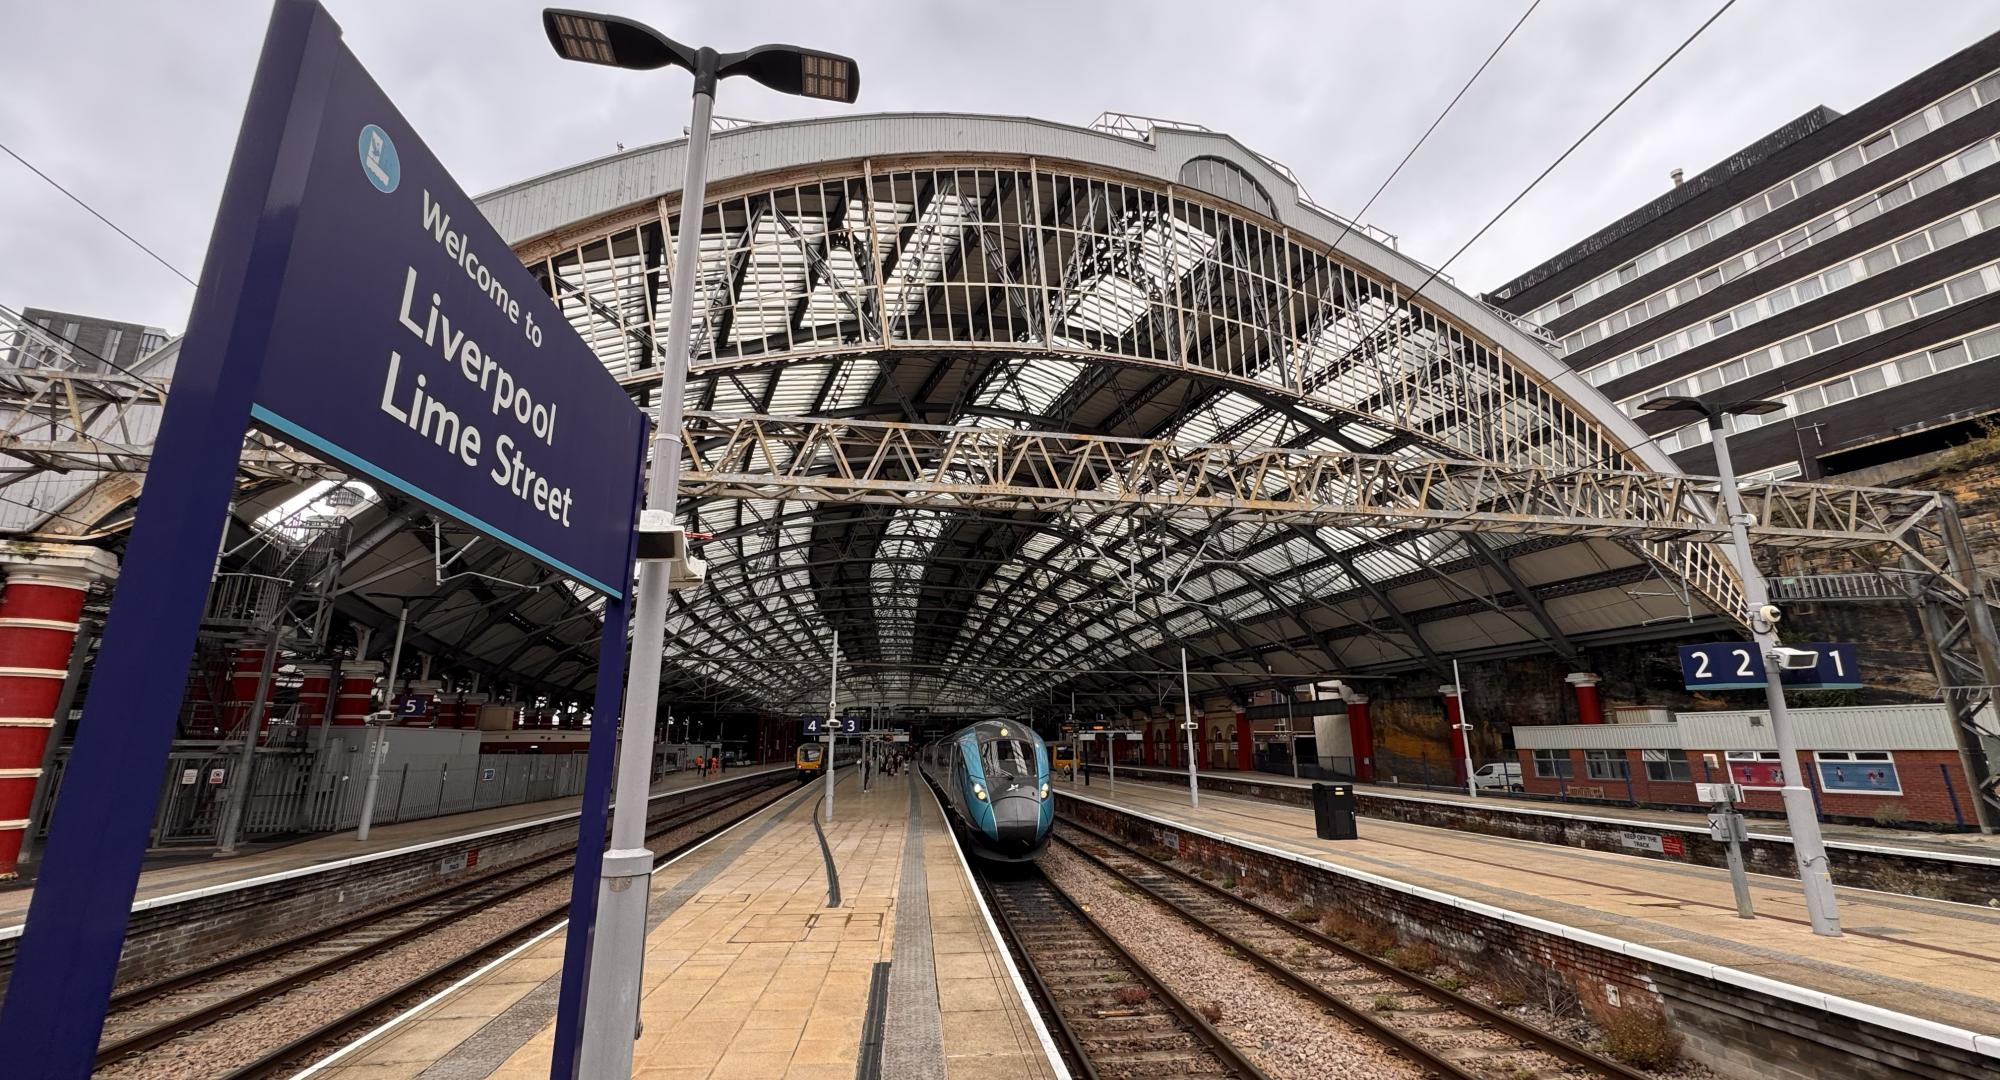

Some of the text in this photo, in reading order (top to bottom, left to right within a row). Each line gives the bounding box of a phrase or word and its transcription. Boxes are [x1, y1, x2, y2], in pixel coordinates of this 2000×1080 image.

[423, 188, 543, 348] Welcome to
[398, 265, 557, 446] Liverpool
[380, 350, 573, 528] Lime Street
[1691, 649, 1754, 678] 2 2
[1829, 650, 1844, 677] 1
[405, 699, 417, 713] 5
[808, 720, 817, 732] 4
[847, 720, 856, 732] 3
